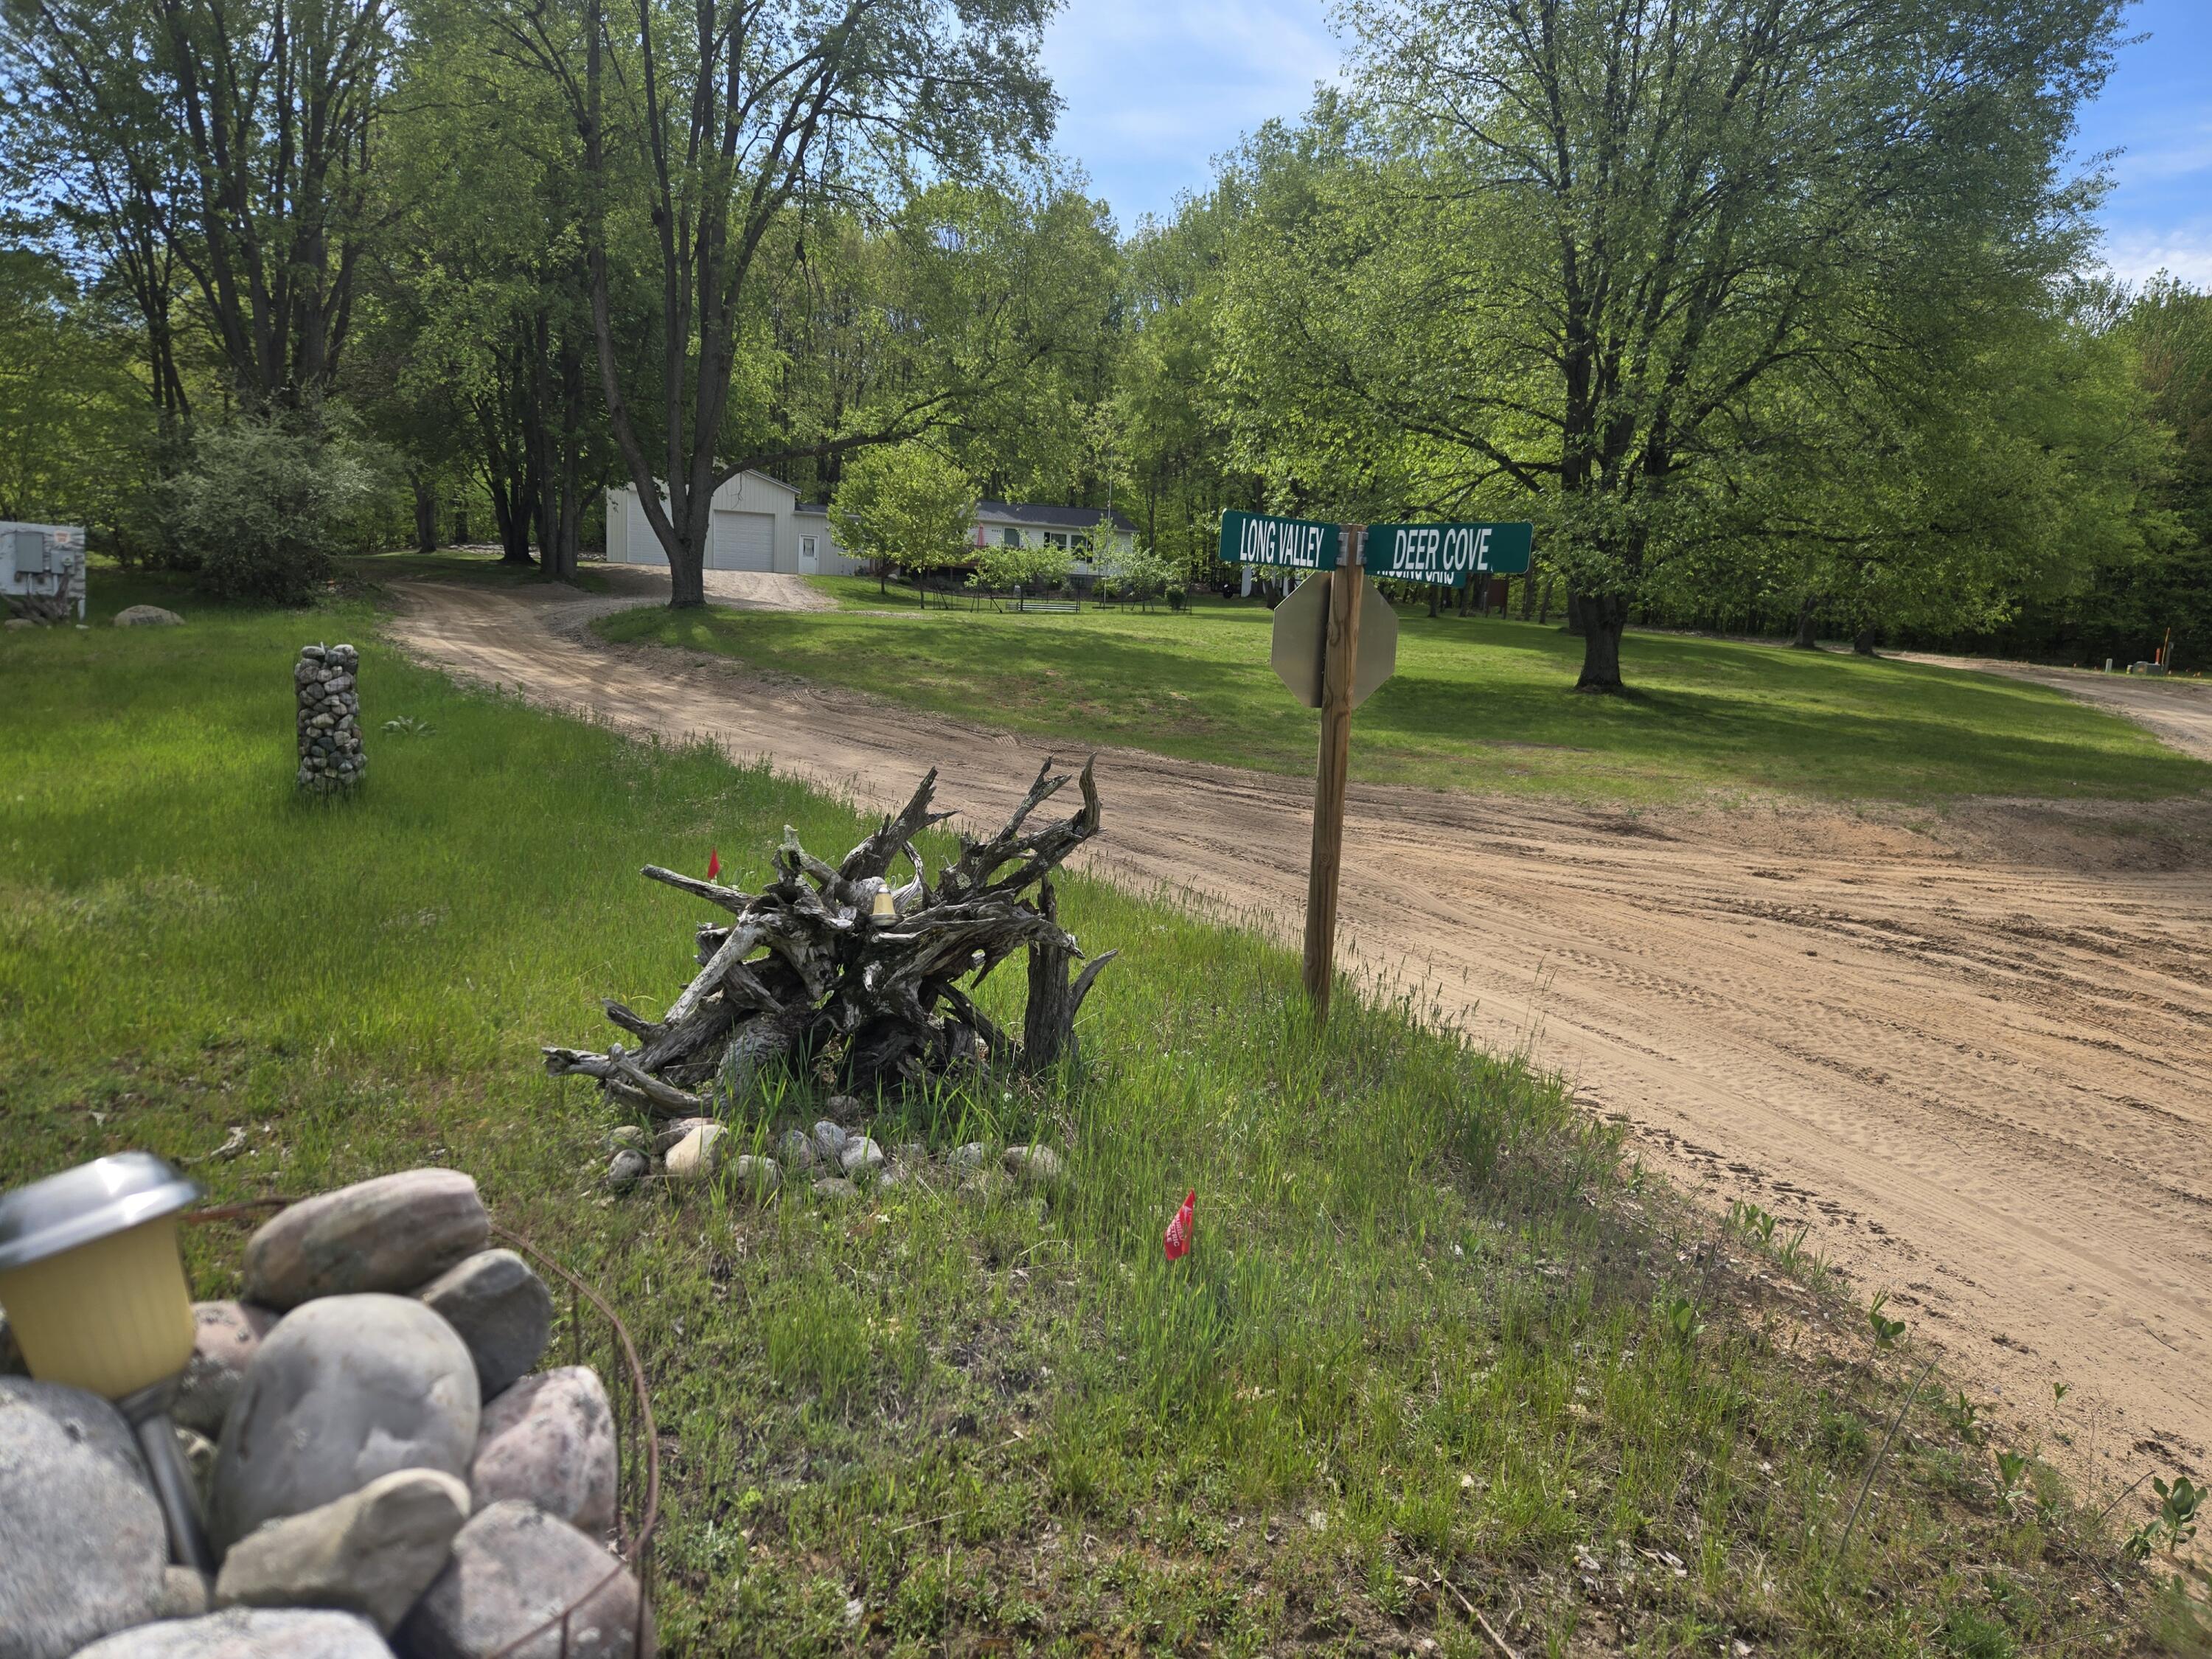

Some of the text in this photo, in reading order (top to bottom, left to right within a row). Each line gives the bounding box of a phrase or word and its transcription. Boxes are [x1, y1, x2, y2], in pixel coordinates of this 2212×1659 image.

[1239, 518, 1324, 568] LONG VALLEY
[1393, 528, 1492, 570] DEER COVE
